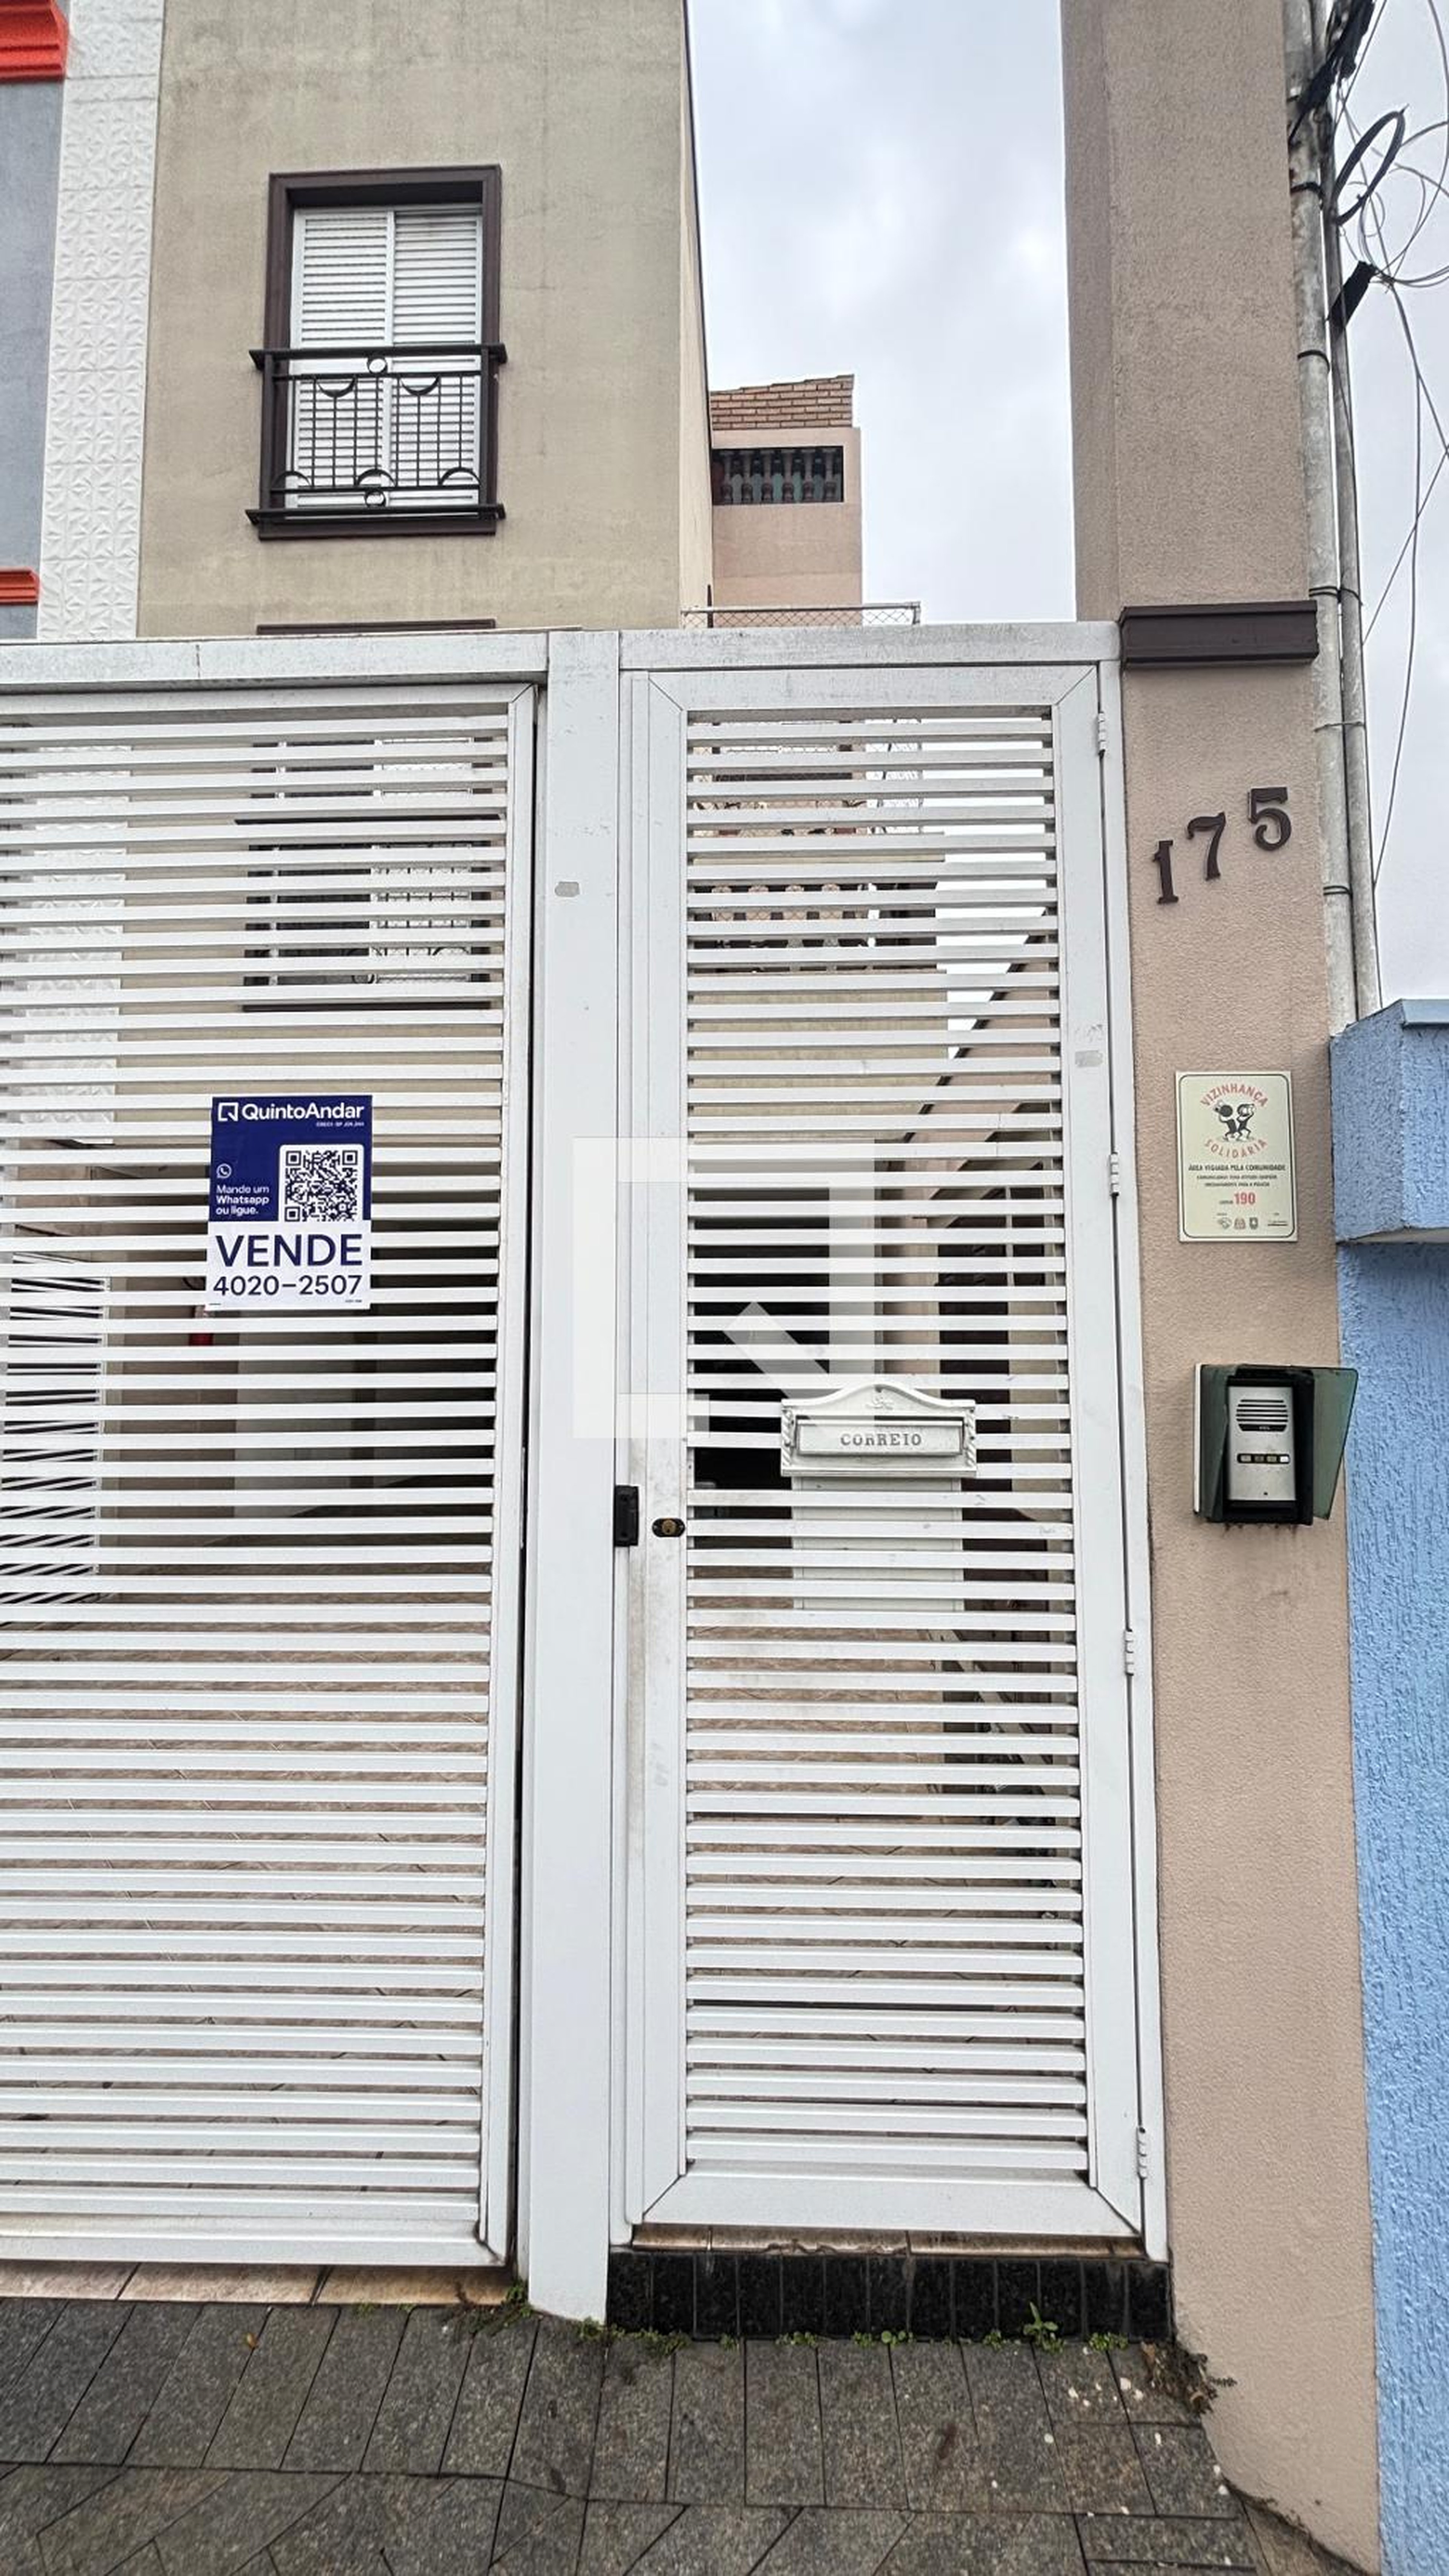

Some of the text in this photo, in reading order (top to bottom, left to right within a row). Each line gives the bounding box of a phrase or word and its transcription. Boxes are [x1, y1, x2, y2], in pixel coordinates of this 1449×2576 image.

[1152, 787, 1292, 904] 175
[1200, 1083, 1268, 1106] VIZINHANÇA
[242, 1103, 365, 1120] QuintoAndar
[216, 1184, 251, 1193] Mande
[216, 1195, 269, 1206] Whatsapp
[1234, 1192, 1255, 1205] 190
[231, 1206, 258, 1216] ligue.
[215, 1234, 363, 1267] VENDE
[213, 1275, 363, 1295] 4020-2507
[840, 1433, 922, 1446] CORREIO
